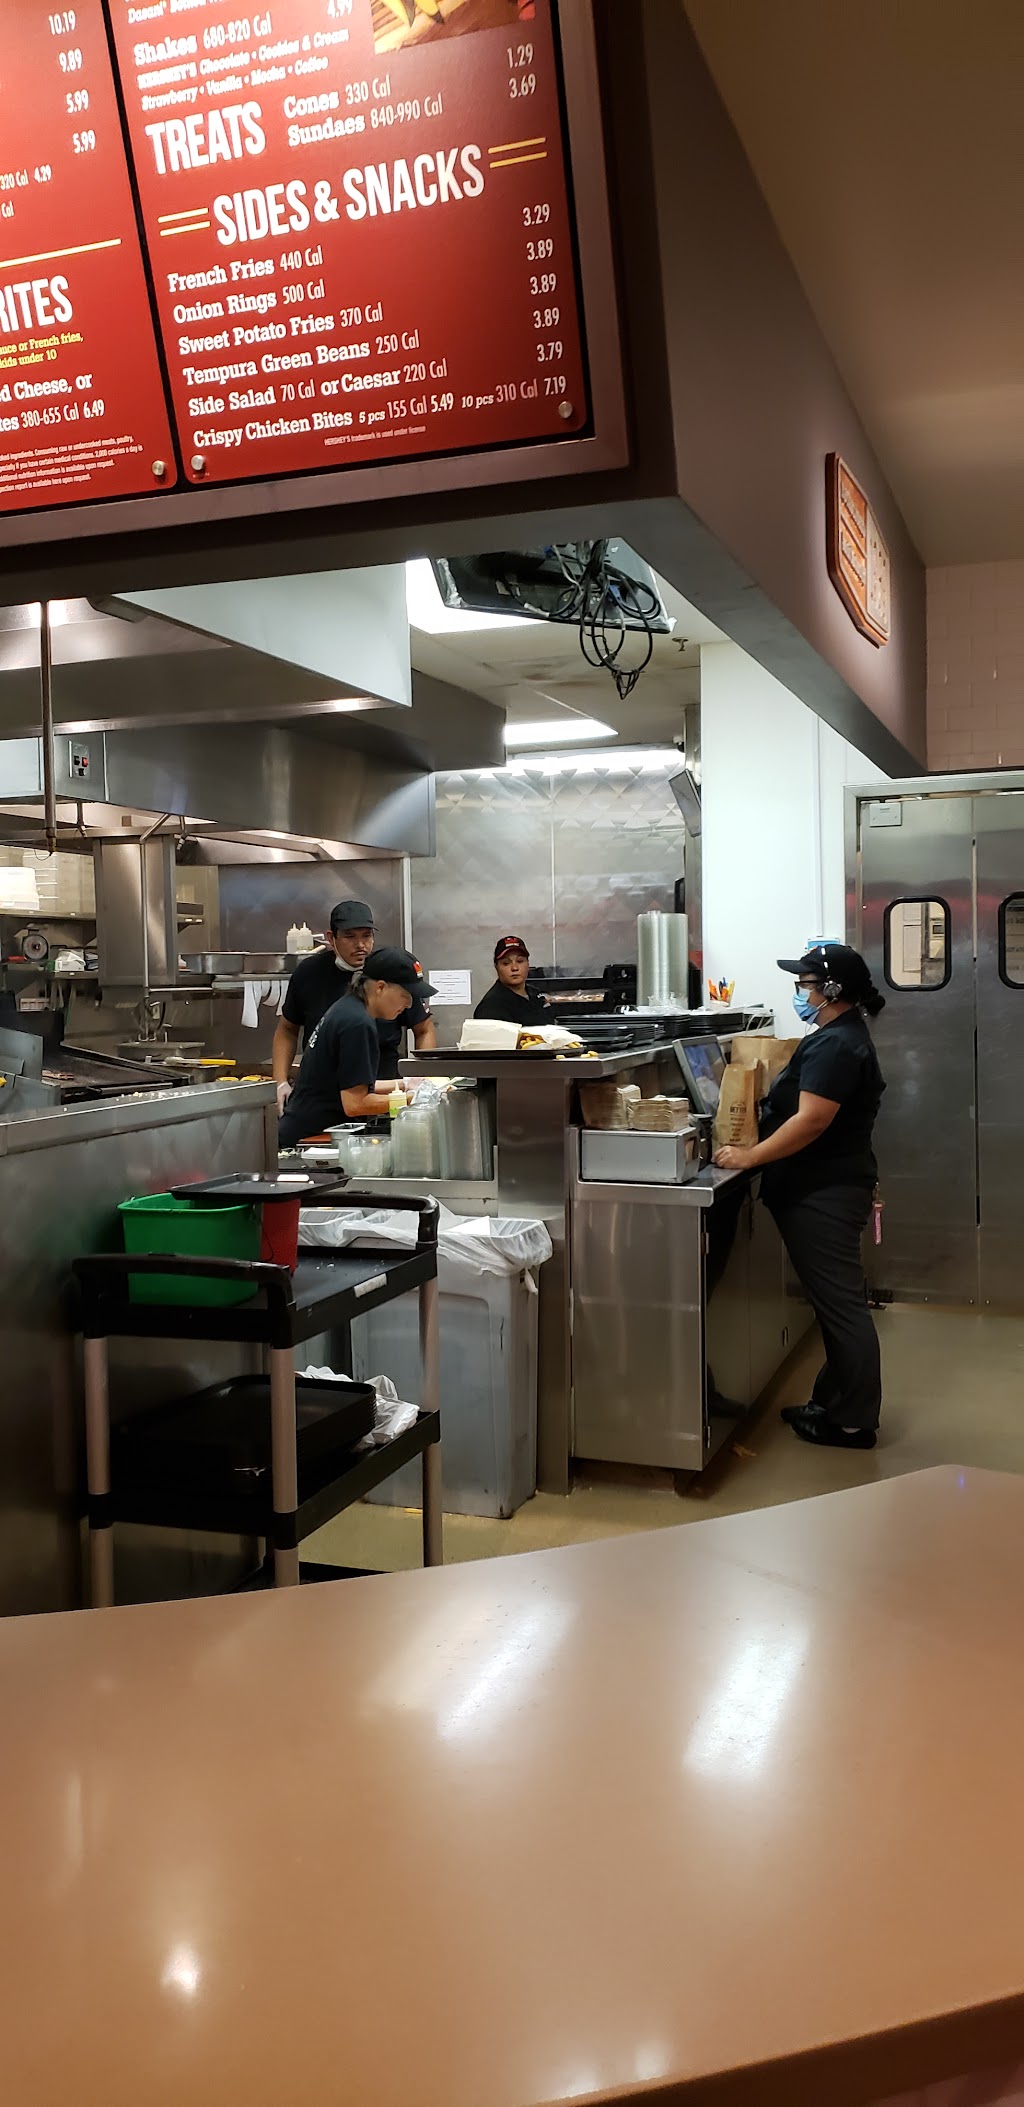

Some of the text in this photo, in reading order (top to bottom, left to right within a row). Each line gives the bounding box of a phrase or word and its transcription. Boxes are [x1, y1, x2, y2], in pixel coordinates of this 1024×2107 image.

[48, 10, 76, 35] 10.19
[134, 35, 197, 66] Shakes
[203, 18, 250, 49] 680-820
[253, 11, 272, 37] Cal
[59, 48, 83, 73] 9.89
[283, 43, 533, 119] Cones 330 Cal 1.29
[65, 89, 89, 113] 5.99
[141, 87, 198, 111] Strawberry
[288, 73, 536, 147] Sundaes 840-990 Cal 3.69
[72, 129, 96, 154] 5.99
[145, 101, 266, 175] TREATS
[16, 169, 29, 187] Cal
[213, 143, 484, 245] SIDES & SNACKS
[1, 200, 14, 218] Cal
[167, 203, 550, 293] French Fries 440 Cal 3.29
[173, 238, 554, 324] Onion Rings 500 Cal 3.89
[178, 273, 557, 355] Sweet Potato Fries 370 Cal 3.89
[18, 352, 43, 365] under
[46, 349, 57, 360] 10
[19, 343, 28, 351] or
[29, 335, 60, 349] French
[60, 332, 83, 344] fries,
[183, 307, 560, 386] Tempura Green Beans 250 Cal 3.89
[14, 378, 73, 400] Cheese,
[75, 373, 93, 390] or
[189, 341, 563, 417] Side Salad 70 Cal or Caesar 220 Cal 3.79
[21, 406, 61, 428] 380-655
[63, 402, 79, 421] Cal
[83, 399, 105, 419] 6.49
[193, 375, 566, 448] Crispy Chicken Bites 5 pcs 155 Cal 5.49 10 pcs 310 Cal 7.19
